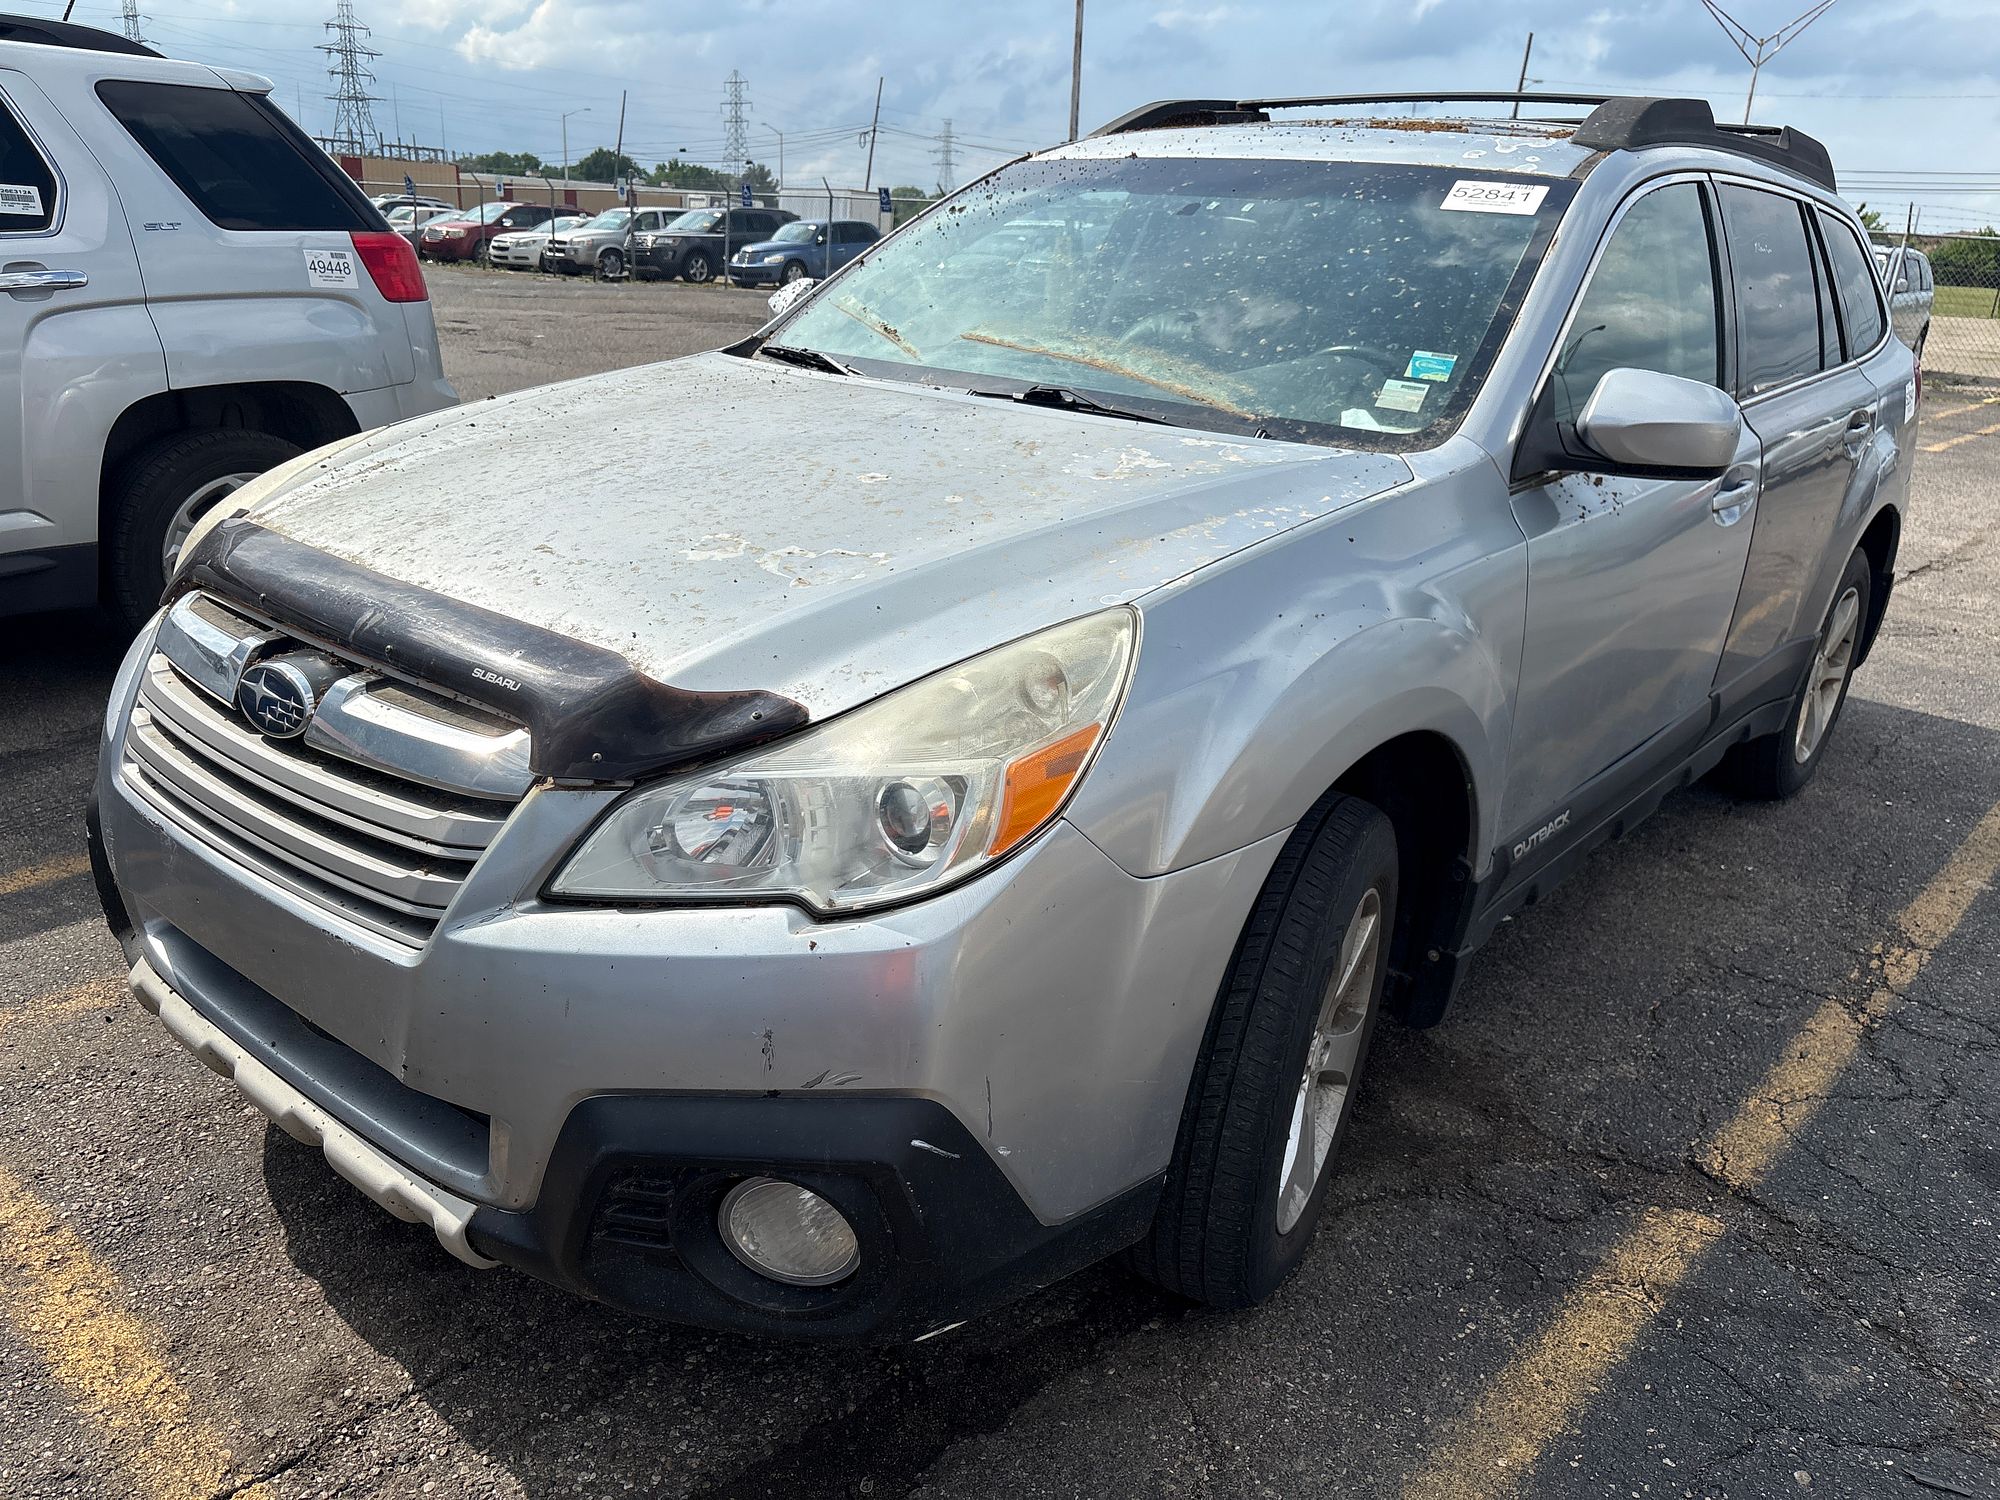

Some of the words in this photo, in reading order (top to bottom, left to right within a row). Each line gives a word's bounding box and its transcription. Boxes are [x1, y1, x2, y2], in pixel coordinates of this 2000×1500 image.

[1453, 187, 1531, 202] 52841
[143, 222, 182, 231] SLT
[309, 259, 352, 276] 49448
[471, 667, 522, 691] SUBARU
[1512, 809, 1570, 860] OUTBACK
